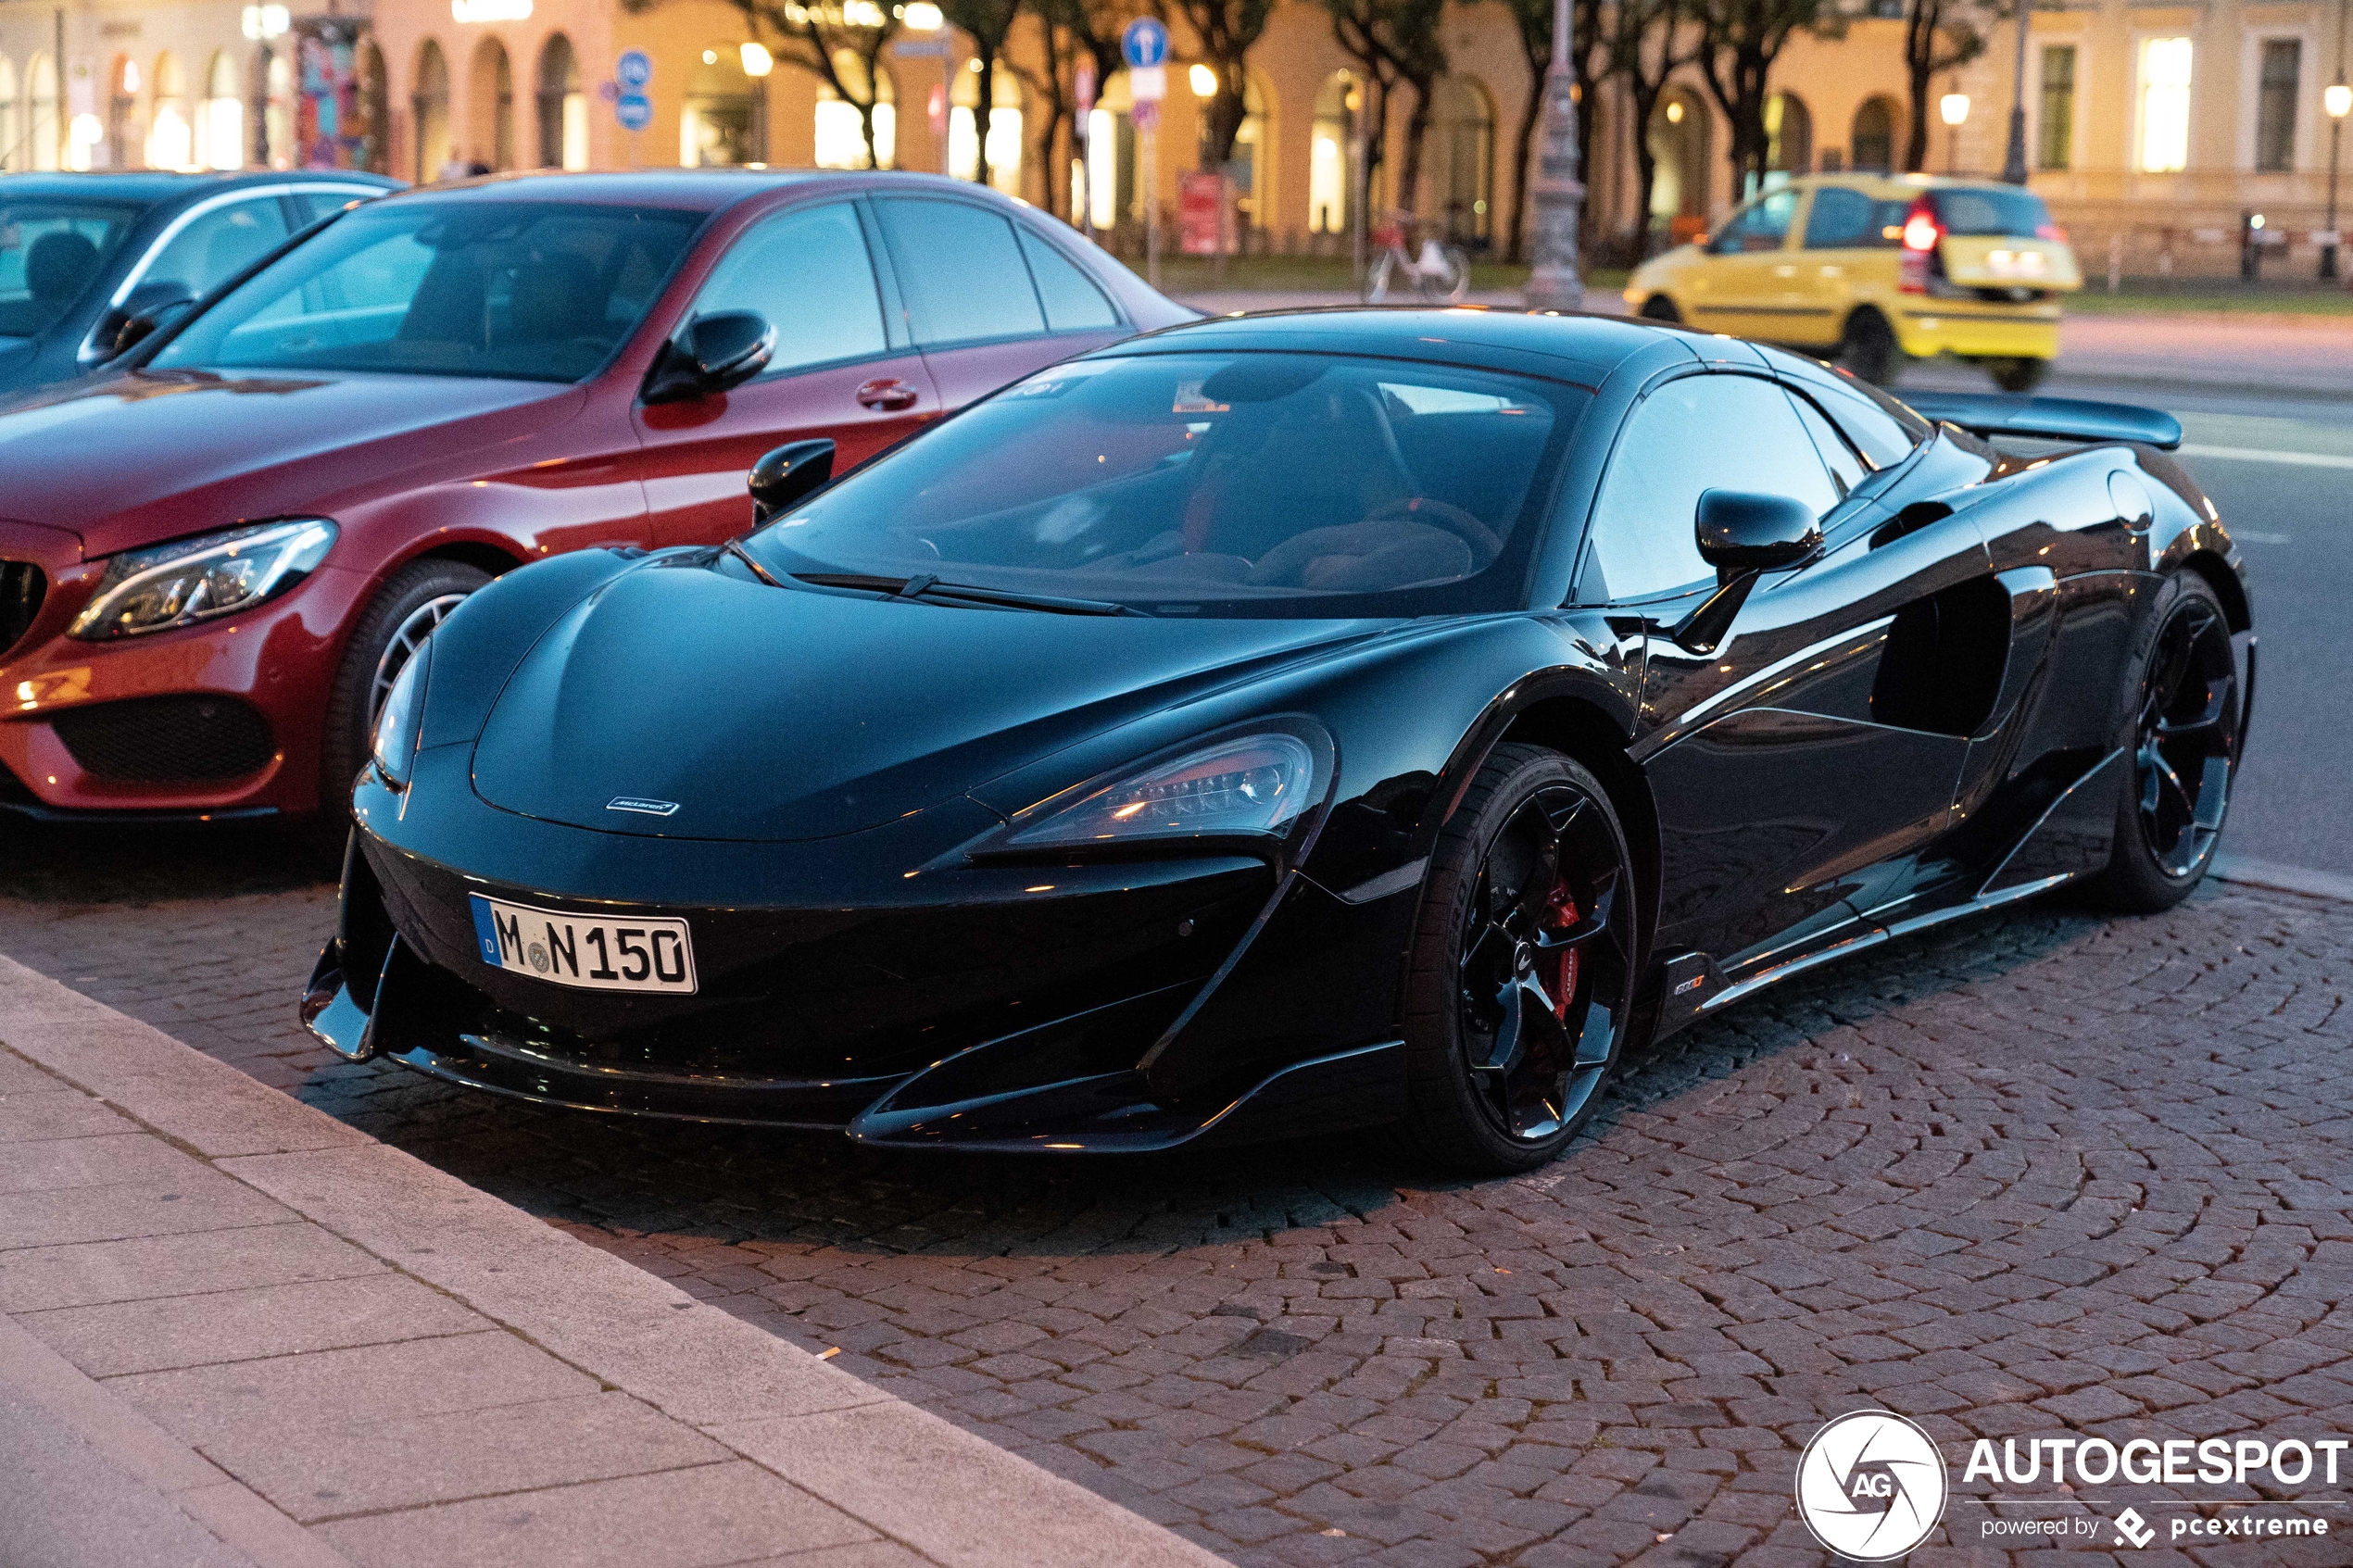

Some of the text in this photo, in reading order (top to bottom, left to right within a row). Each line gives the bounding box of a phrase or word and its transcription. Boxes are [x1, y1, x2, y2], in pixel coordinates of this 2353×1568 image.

[614, 800, 664, 810] McLaren
[495, 910, 525, 965] M
[485, 939, 494, 953] D
